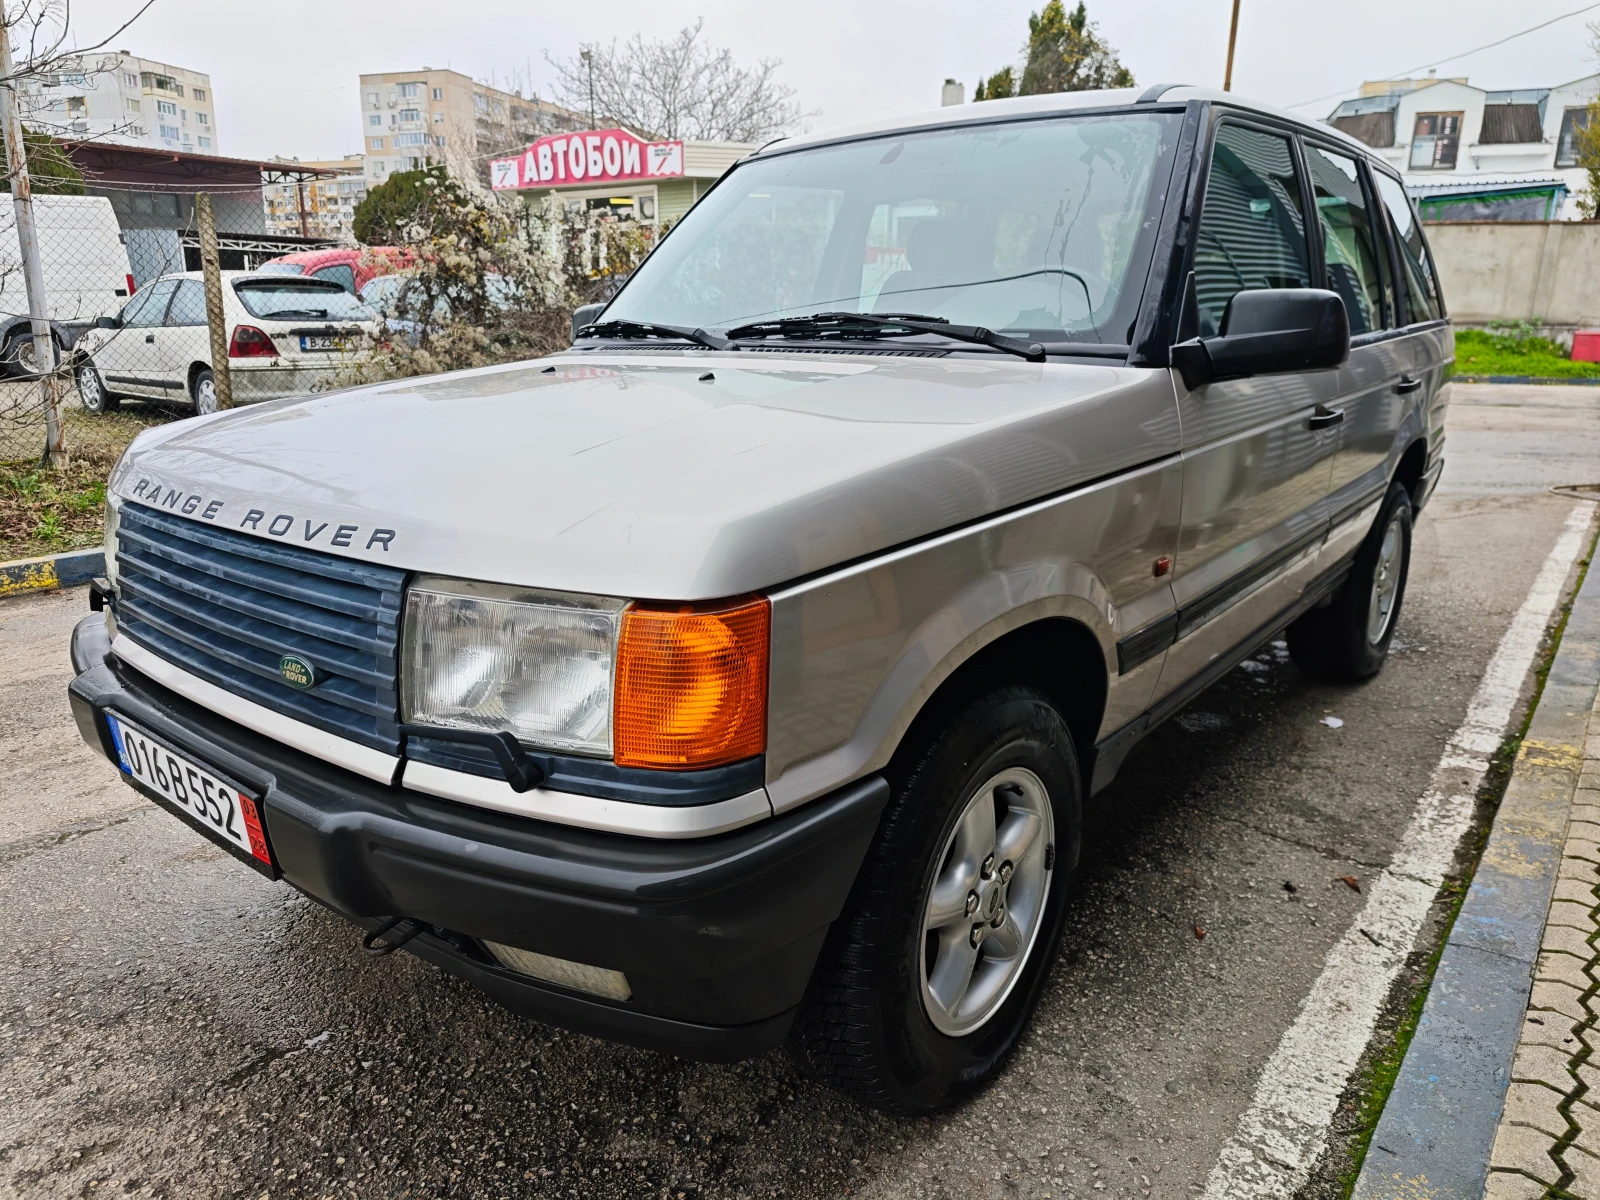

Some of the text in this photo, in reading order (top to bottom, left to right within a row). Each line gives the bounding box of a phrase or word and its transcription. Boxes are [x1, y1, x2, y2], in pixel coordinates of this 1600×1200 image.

[524, 136, 641, 183] АВТОБОИ
[132, 478, 397, 552] RANGE ROVER
[283, 659, 302, 674] LAND
[285, 670, 307, 685] ROVER
[124, 730, 242, 842] 016B552
[242, 799, 257, 820] 03
